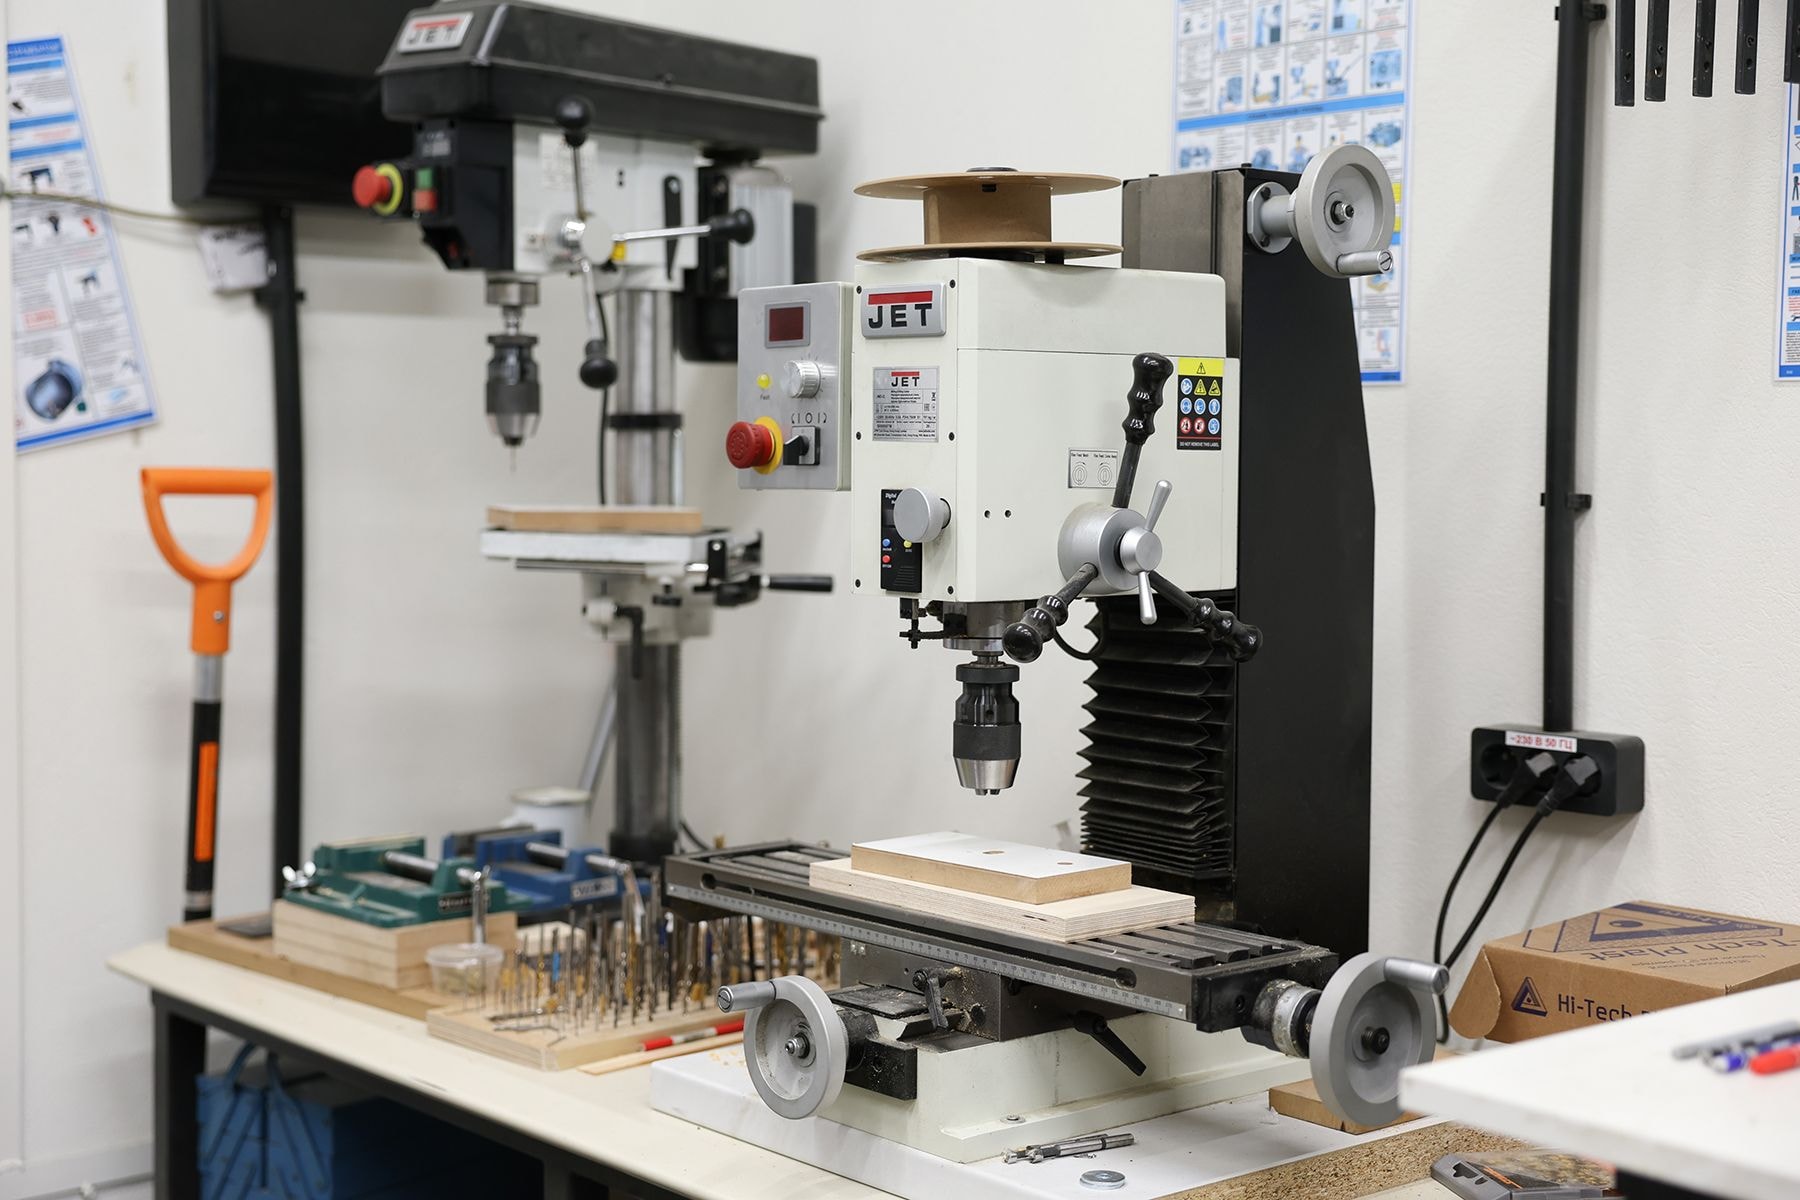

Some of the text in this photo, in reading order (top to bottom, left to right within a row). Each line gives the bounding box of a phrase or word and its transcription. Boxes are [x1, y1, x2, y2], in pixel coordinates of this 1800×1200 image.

[408, 26, 456, 45] JET
[868, 303, 933, 329] JET
[891, 377, 920, 387] JET
[1558, 993, 1633, 1022] Hi-Tech
